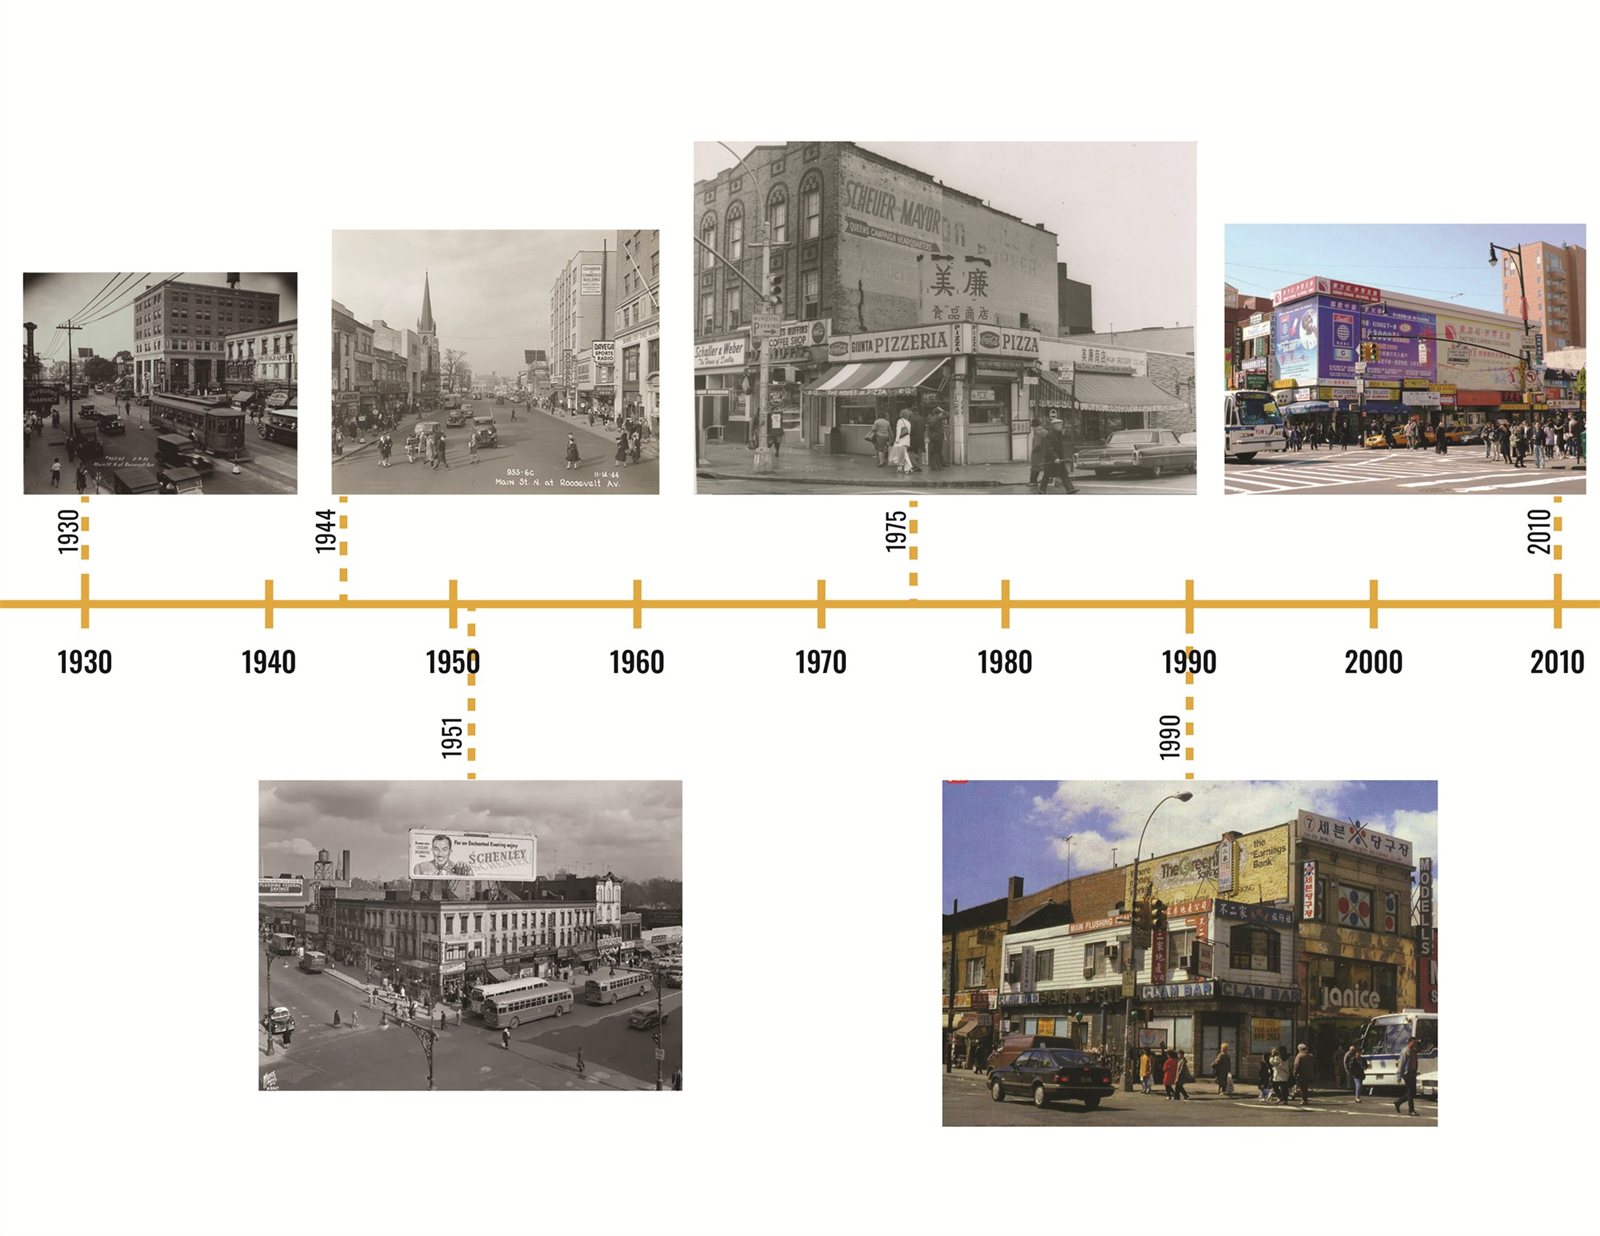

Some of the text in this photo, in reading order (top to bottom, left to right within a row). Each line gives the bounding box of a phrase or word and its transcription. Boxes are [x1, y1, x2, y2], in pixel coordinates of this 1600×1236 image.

[843, 179, 897, 222] SCHEUER
[900, 199, 942, 235] MAYOR
[849, 222, 870, 236] QUEENS
[930, 263, 989, 297] 美廉
[723, 342, 744, 354] Weber
[768, 335, 806, 347] COFFEE SHOP
[852, 331, 948, 353] GIUNTA PIZZERIA
[1002, 334, 1039, 352] PIZZA
[1254, 840, 1266, 848] the
[1318, 820, 1346, 840] 세븐
[1370, 834, 1410, 858] 당구장
[468, 848, 527, 865] SCHENLEY
[1253, 844, 1287, 859] Earnings
[1161, 862, 1179, 878] The
[1253, 858, 1273, 869] Bank
[1420, 858, 1431, 956] MODELLS
[1070, 922, 1084, 932] MAIN
[1086, 917, 1112, 930] FLUSHING
[1142, 982, 1212, 1000] CLAM BAR
[1222, 982, 1300, 1003] CLAM BAR
